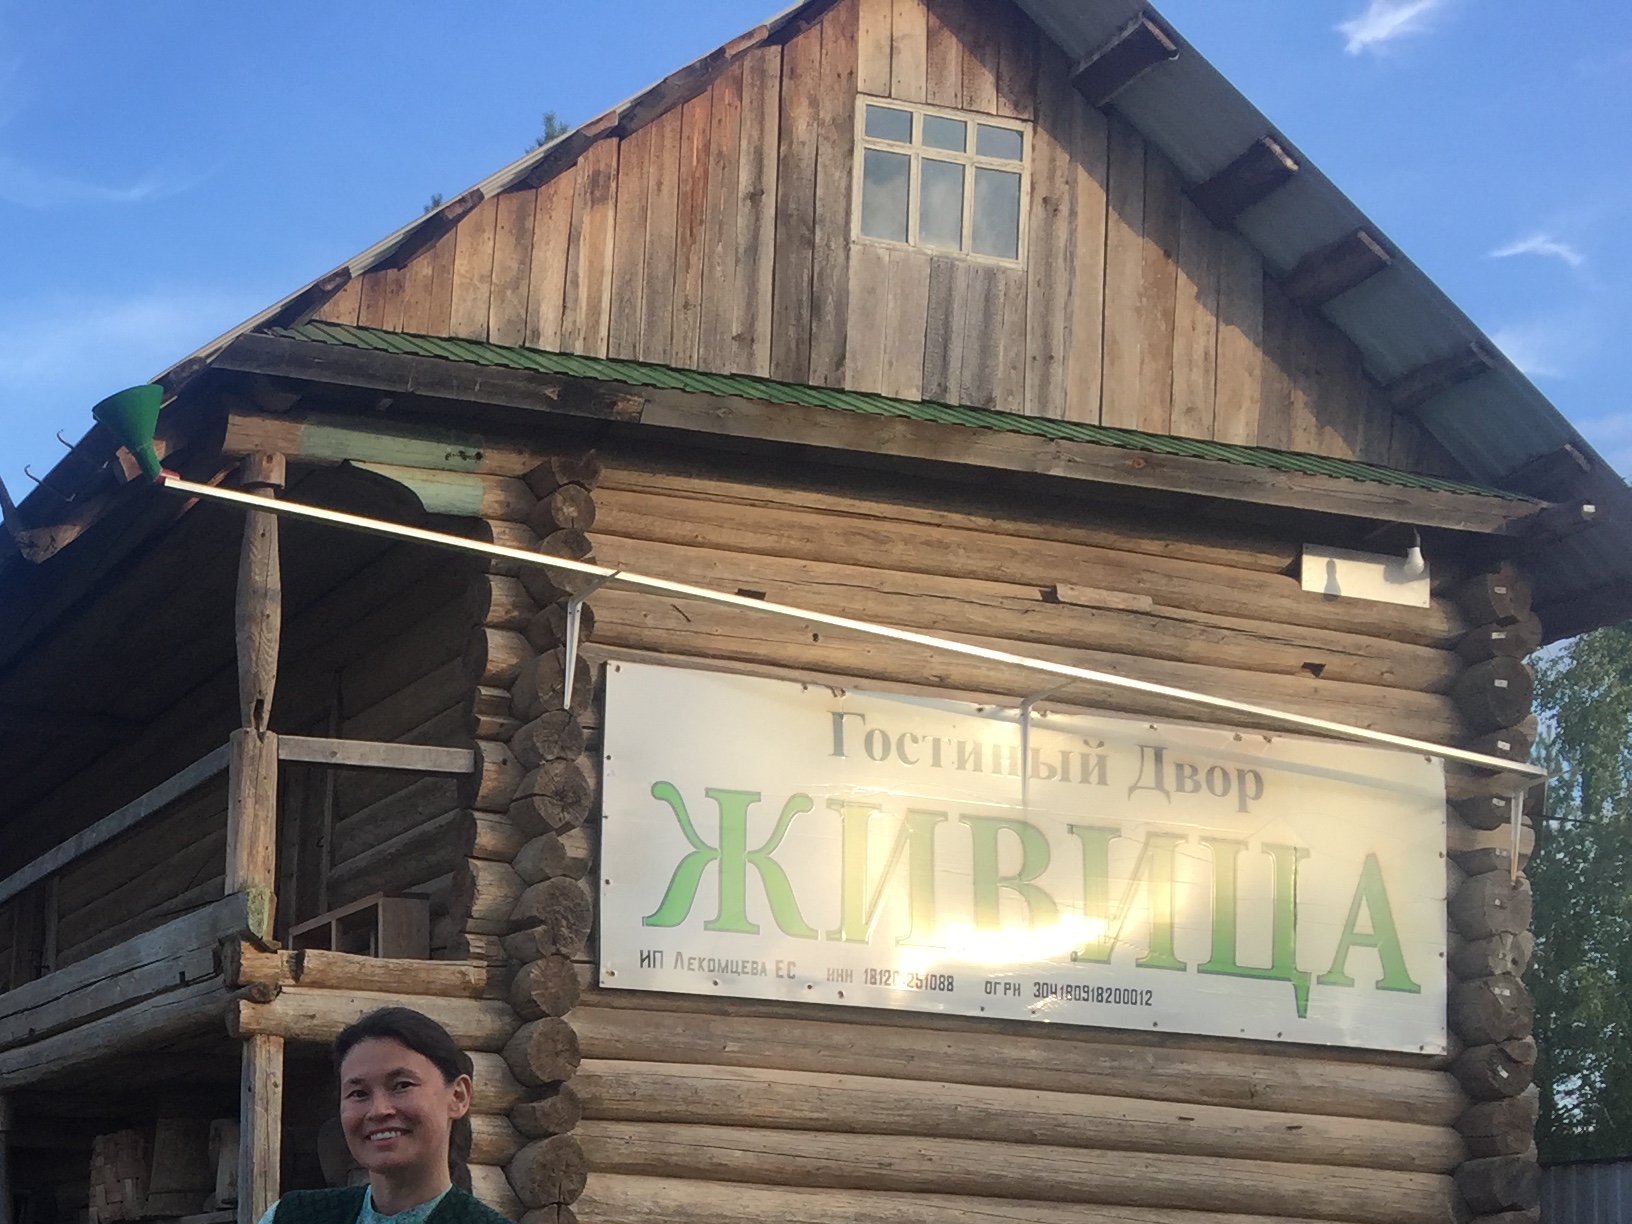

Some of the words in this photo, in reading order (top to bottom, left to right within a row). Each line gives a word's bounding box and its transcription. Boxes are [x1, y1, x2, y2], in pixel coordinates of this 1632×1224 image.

[826, 709, 1110, 788] Гостиный
[1127, 743, 1265, 813] Двор
[641, 779, 1422, 1019] ЖИВИЦА
[639, 949, 664, 969] ИП
[775, 959, 797, 980] ЕС
[826, 967, 854, 984] ИНН
[863, 967, 955, 993] 18120251088
[984, 980, 1022, 997] ОГРН
[1033, 981, 1153, 1007] 304180918200012
